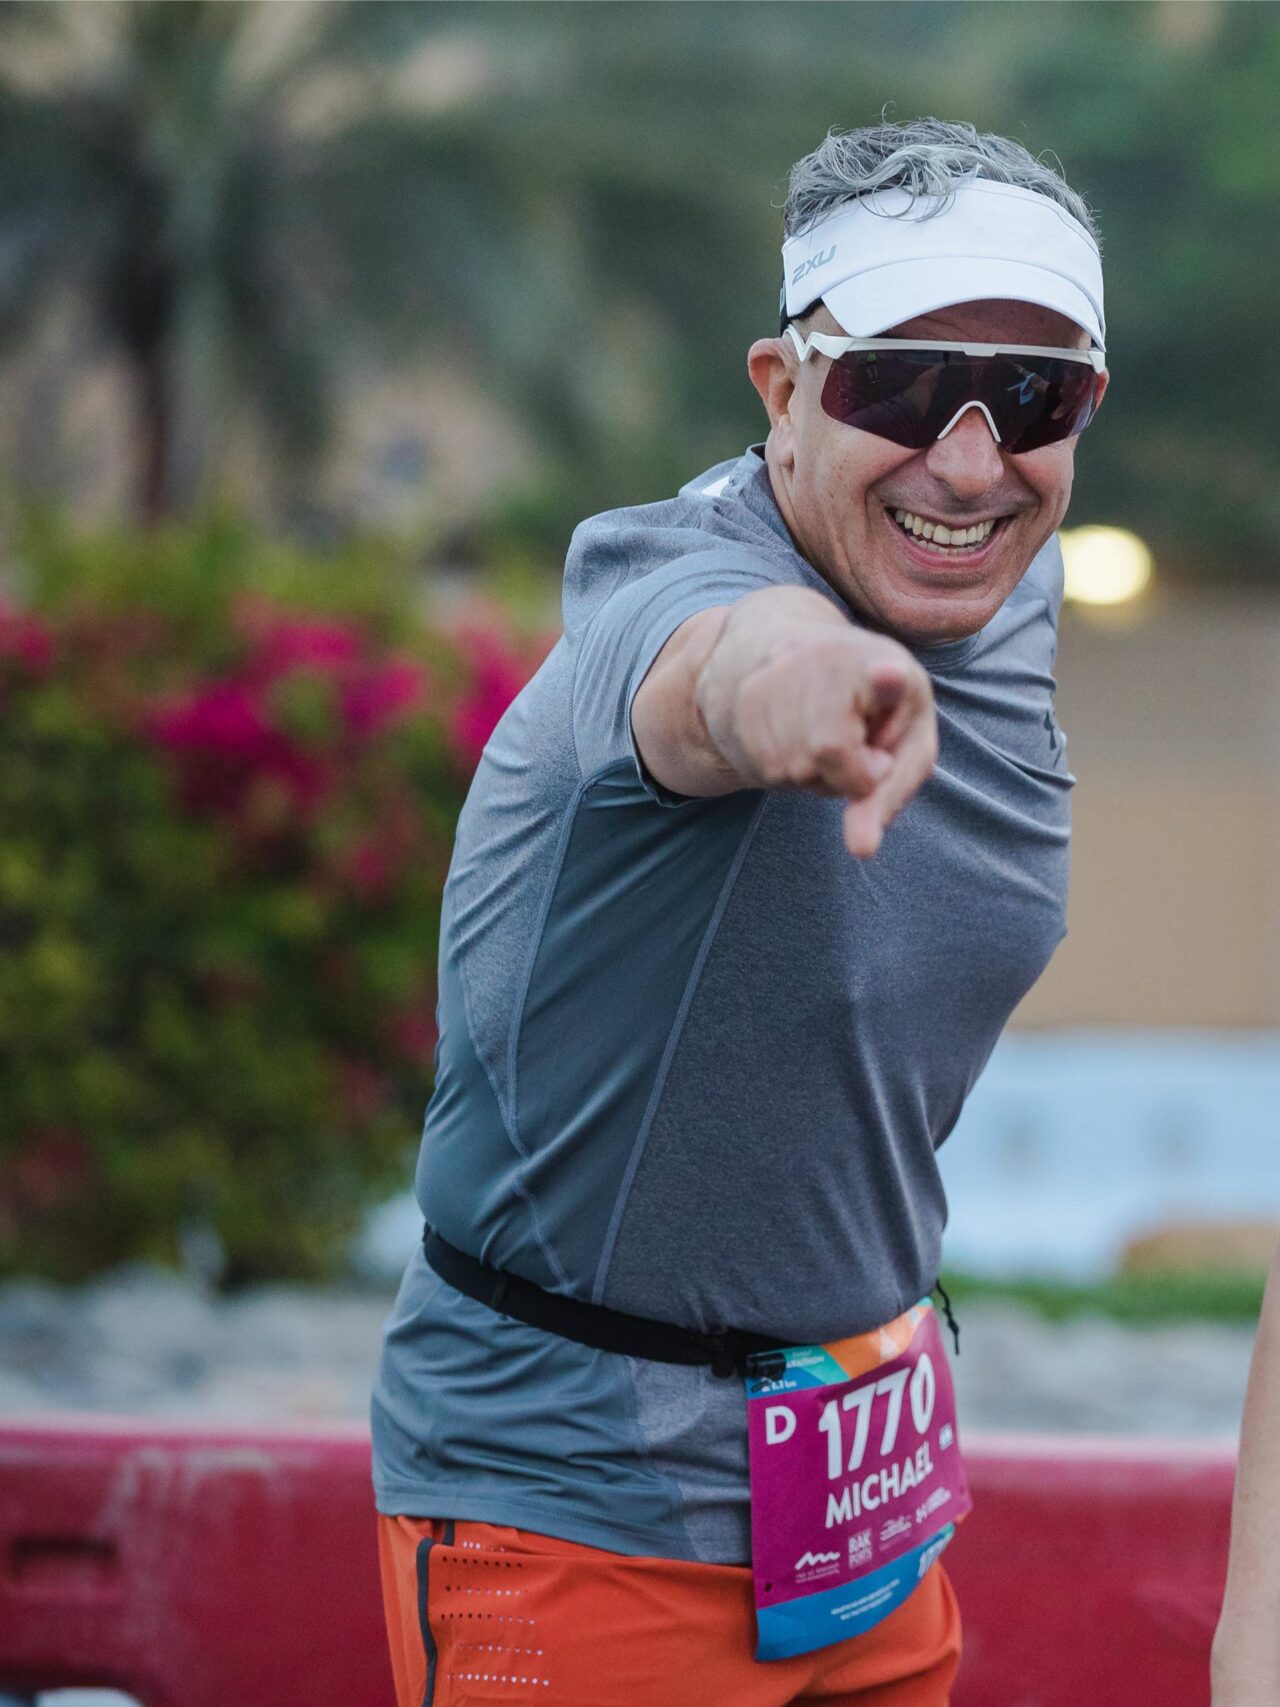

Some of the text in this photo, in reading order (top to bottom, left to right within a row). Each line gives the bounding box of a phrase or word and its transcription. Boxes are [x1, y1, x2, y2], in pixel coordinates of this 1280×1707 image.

[792, 245, 837, 286] 2XU
[765, 1353, 936, 1481] D 1770
[825, 1441, 934, 1529] MICHAEL
